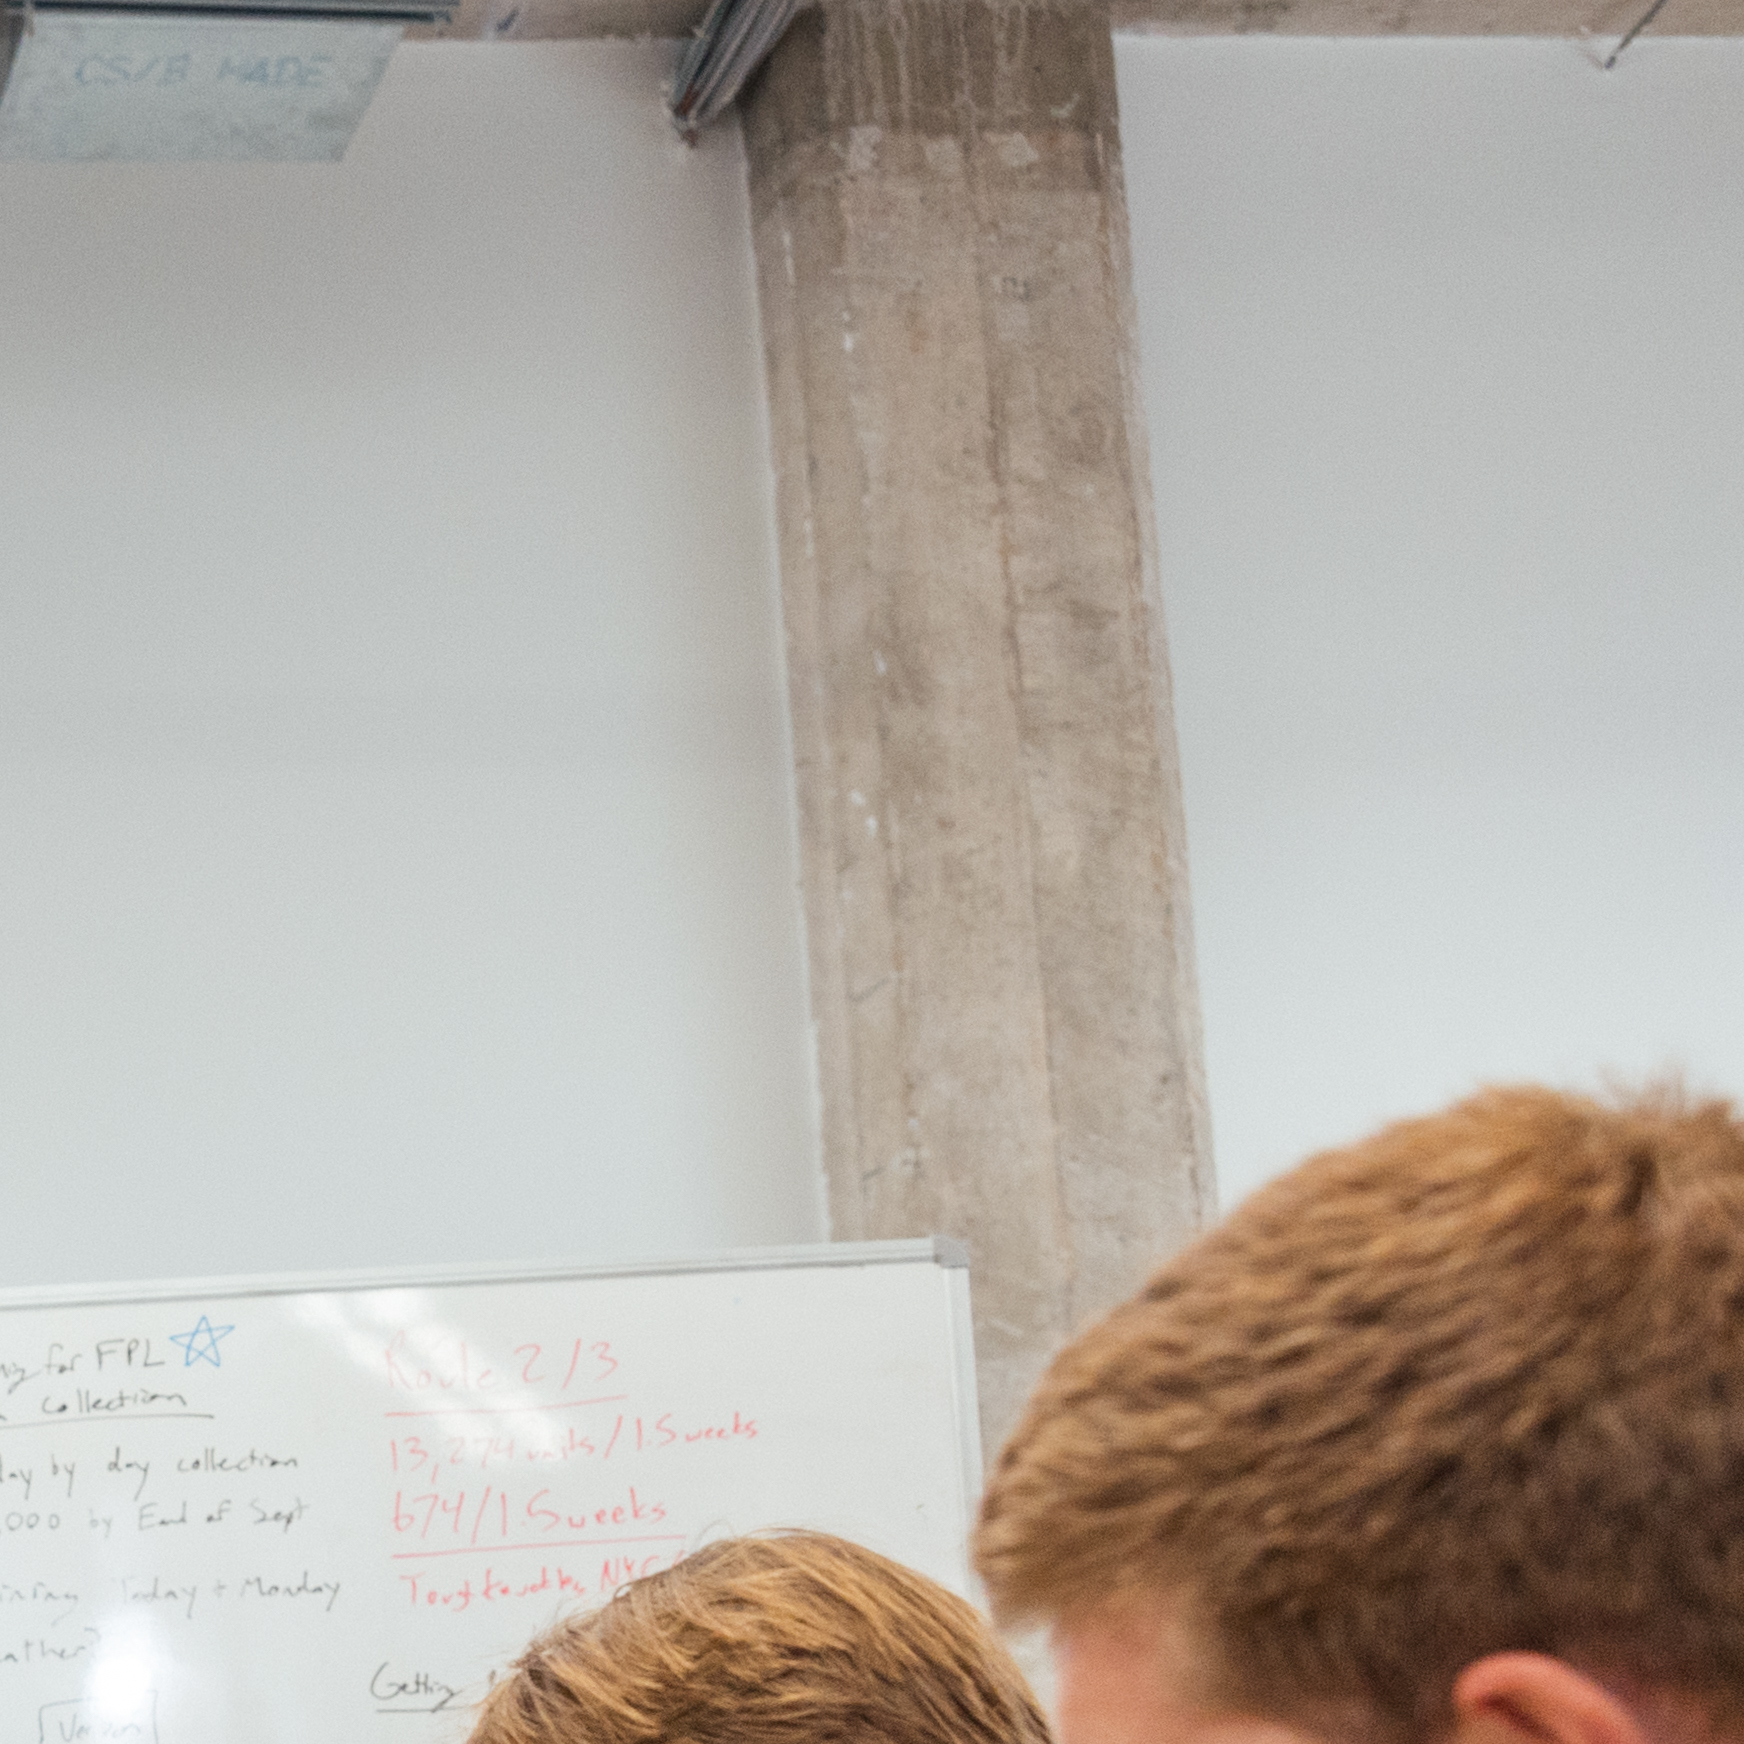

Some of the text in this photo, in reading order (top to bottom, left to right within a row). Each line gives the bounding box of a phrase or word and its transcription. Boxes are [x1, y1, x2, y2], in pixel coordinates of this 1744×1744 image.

[45, 1343, 83, 1376] for
[95, 1338, 166, 1371] FPL
[51, 1453, 77, 1498] by
[107, 1447, 151, 1500] day
[88, 1507, 114, 1538] by
[138, 1501, 187, 1530] End
[206, 1500, 233, 1524] of
